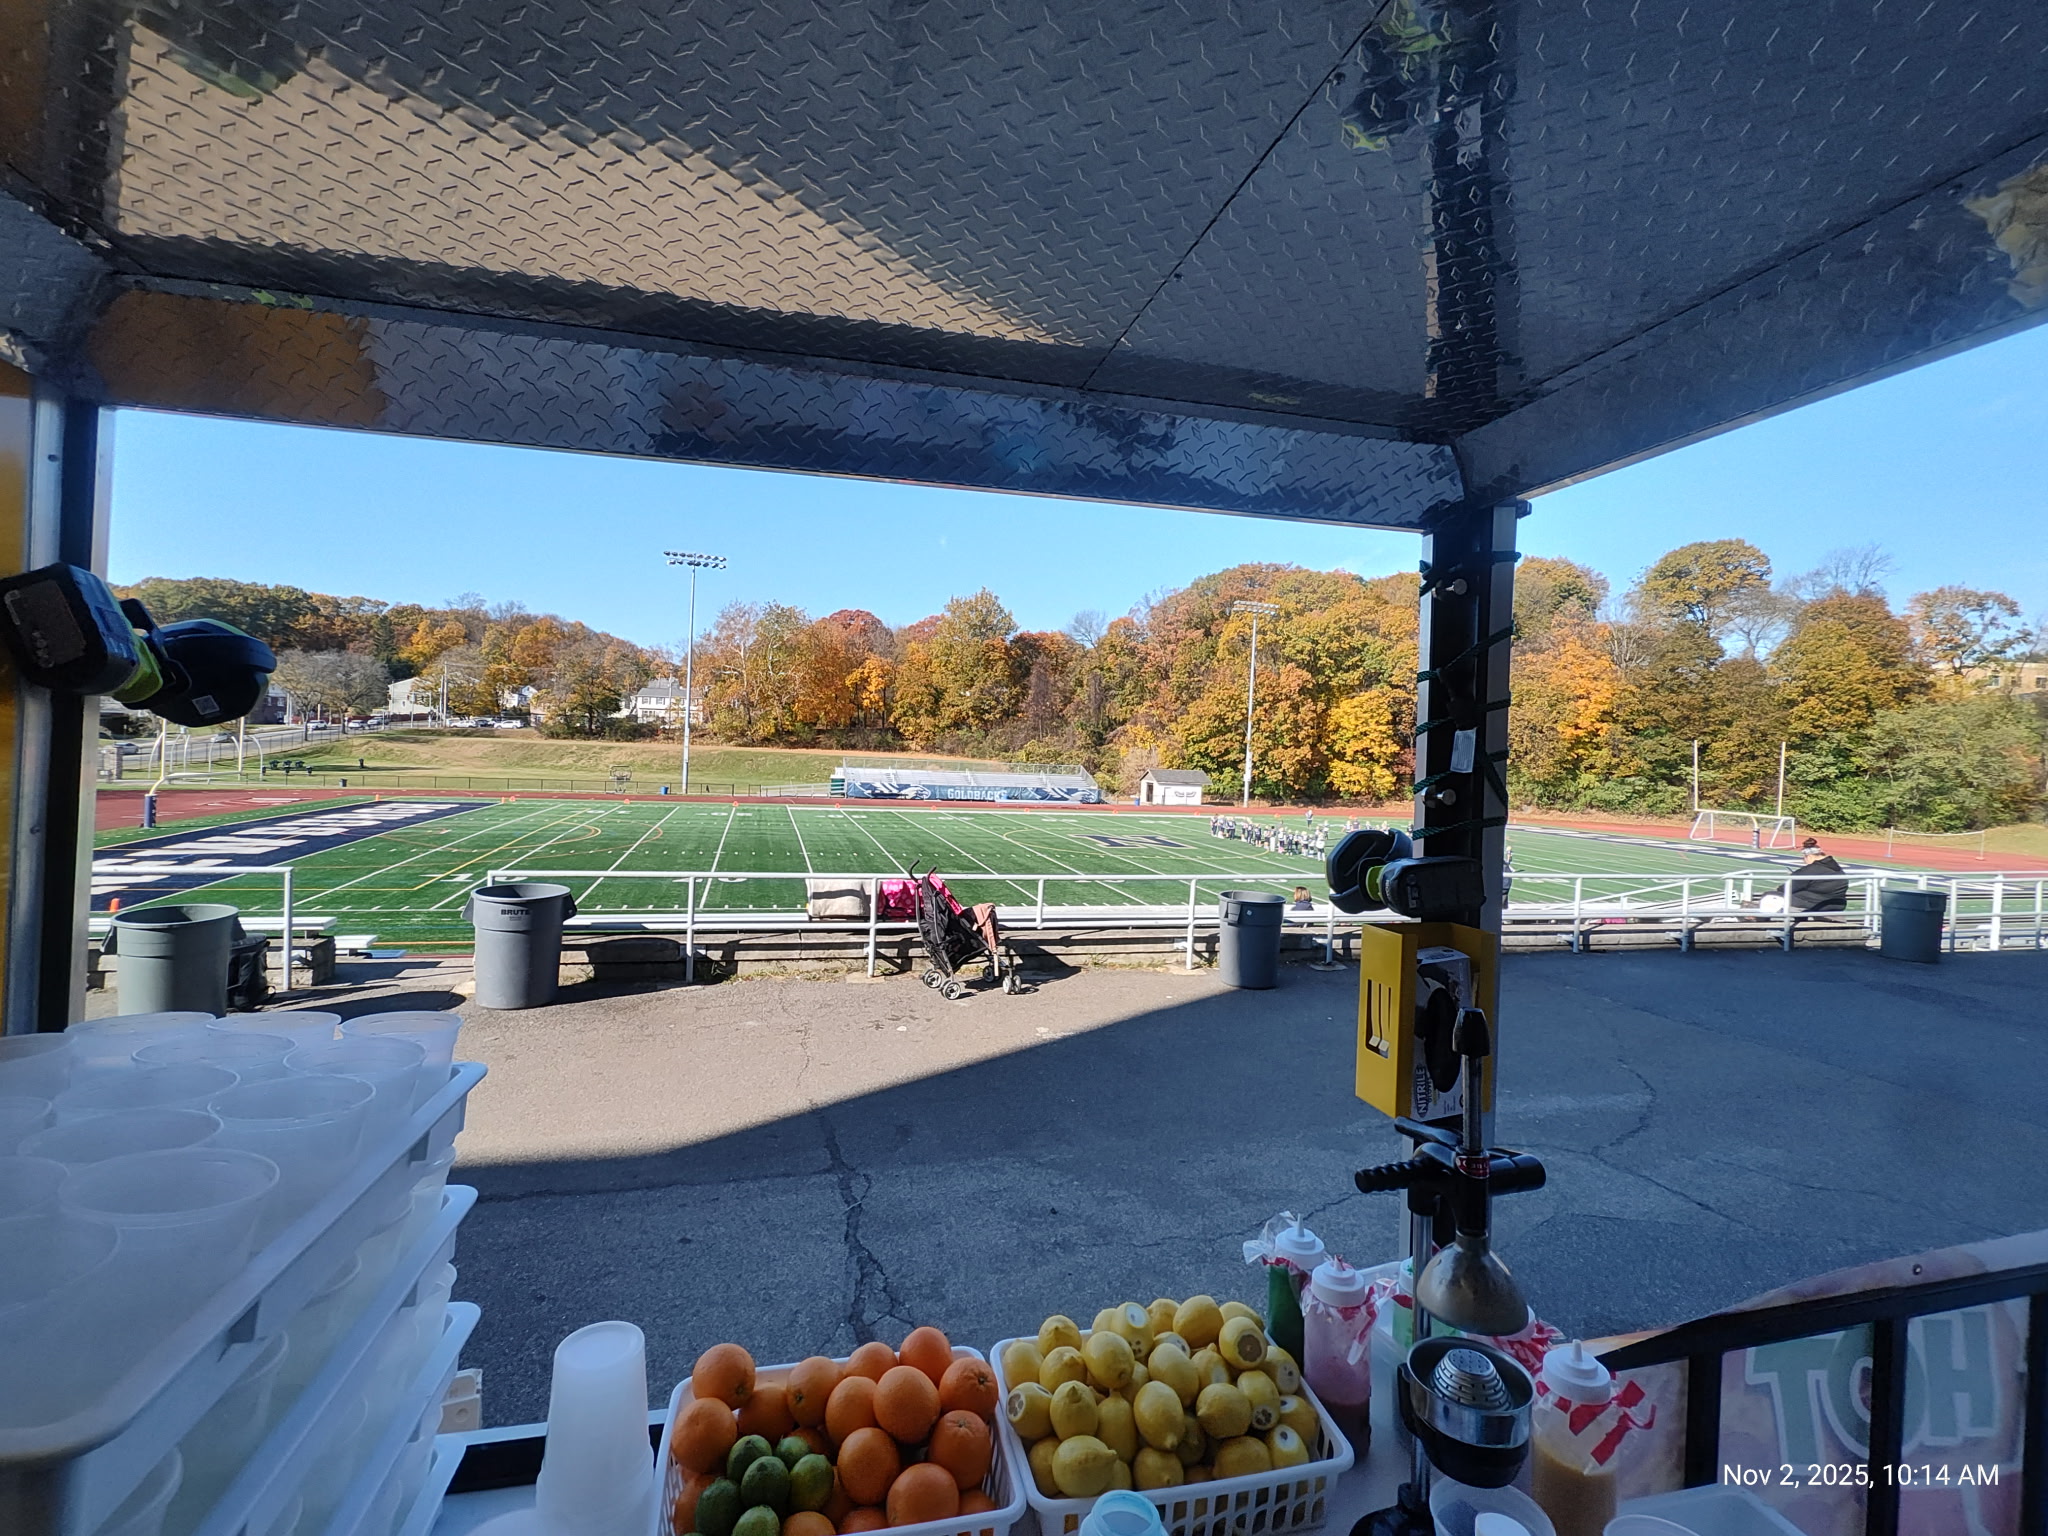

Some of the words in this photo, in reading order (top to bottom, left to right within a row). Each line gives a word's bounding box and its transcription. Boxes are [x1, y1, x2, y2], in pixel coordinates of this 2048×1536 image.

[947, 788, 1007, 801] GOLDBACKS
[501, 908, 531, 916] BRUTE
[1415, 1067, 1427, 1114] NITRILE
